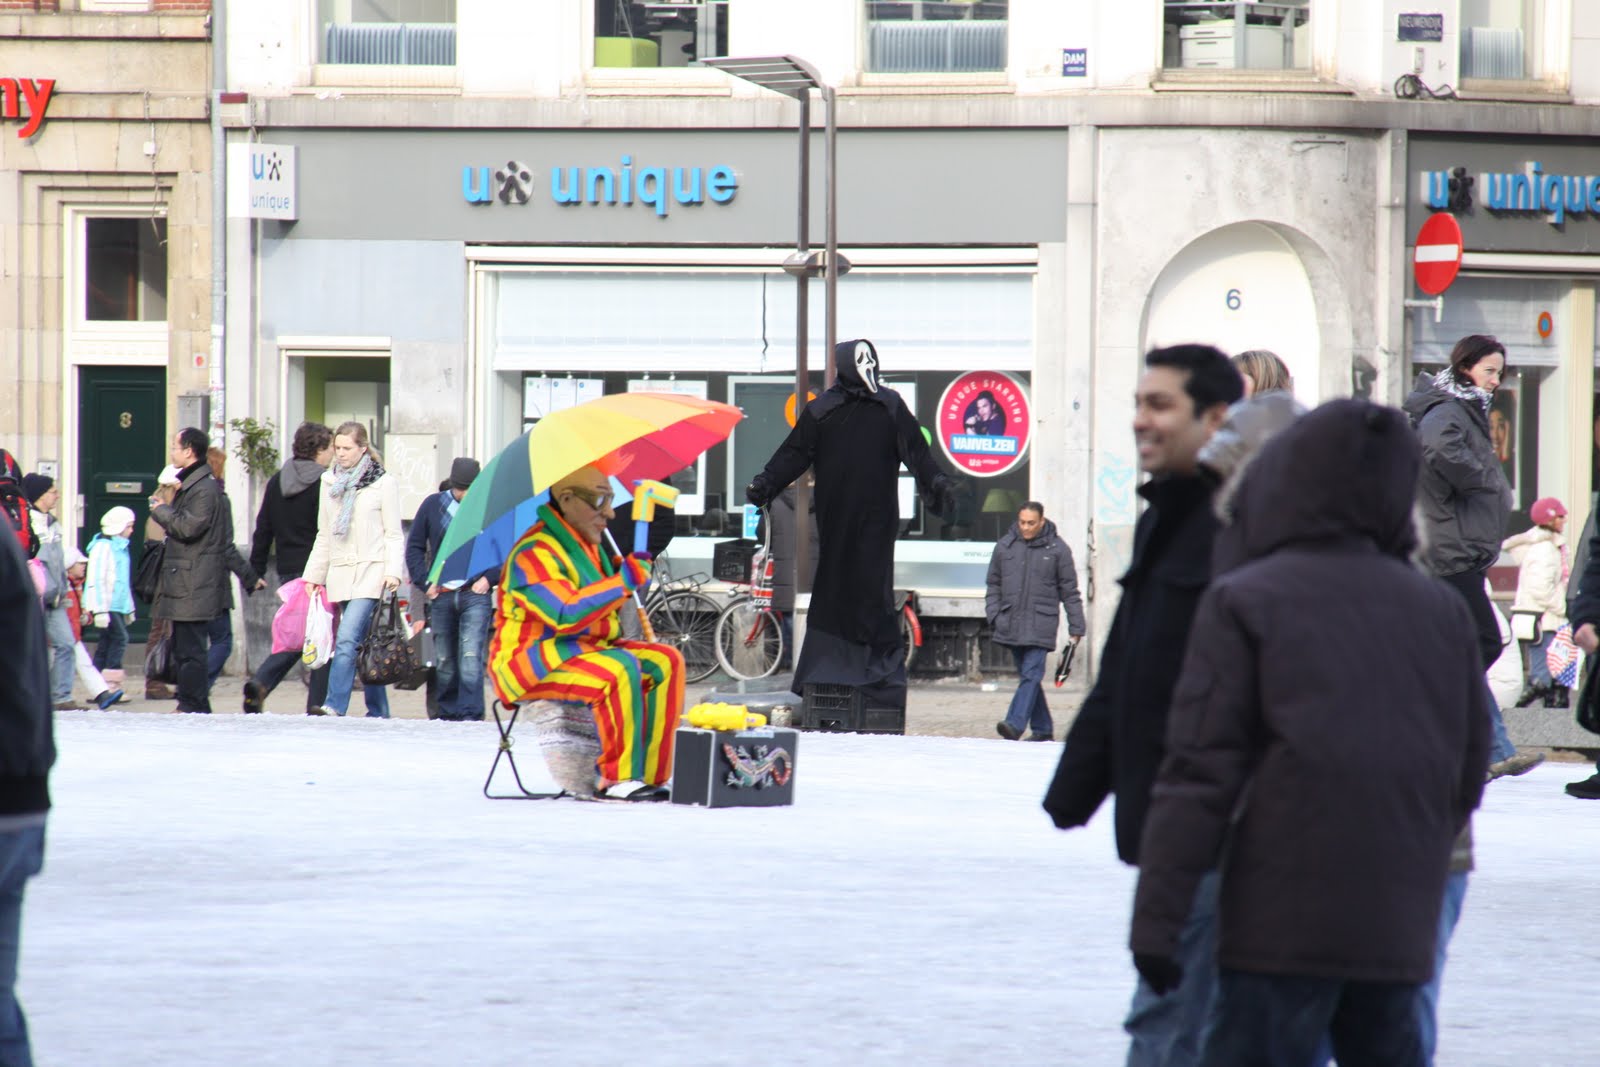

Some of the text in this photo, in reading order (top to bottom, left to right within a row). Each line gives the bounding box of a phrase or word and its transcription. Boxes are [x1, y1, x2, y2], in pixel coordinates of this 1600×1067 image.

[1063, 52, 1086, 65] DAM
[462, 155, 738, 217] u unique
[252, 191, 290, 213] unique
[1226, 288, 1242, 310] 6
[948, 379, 1022, 423] UNIQUE STARRING
[952, 436, 1016, 453] VANVELZEN
